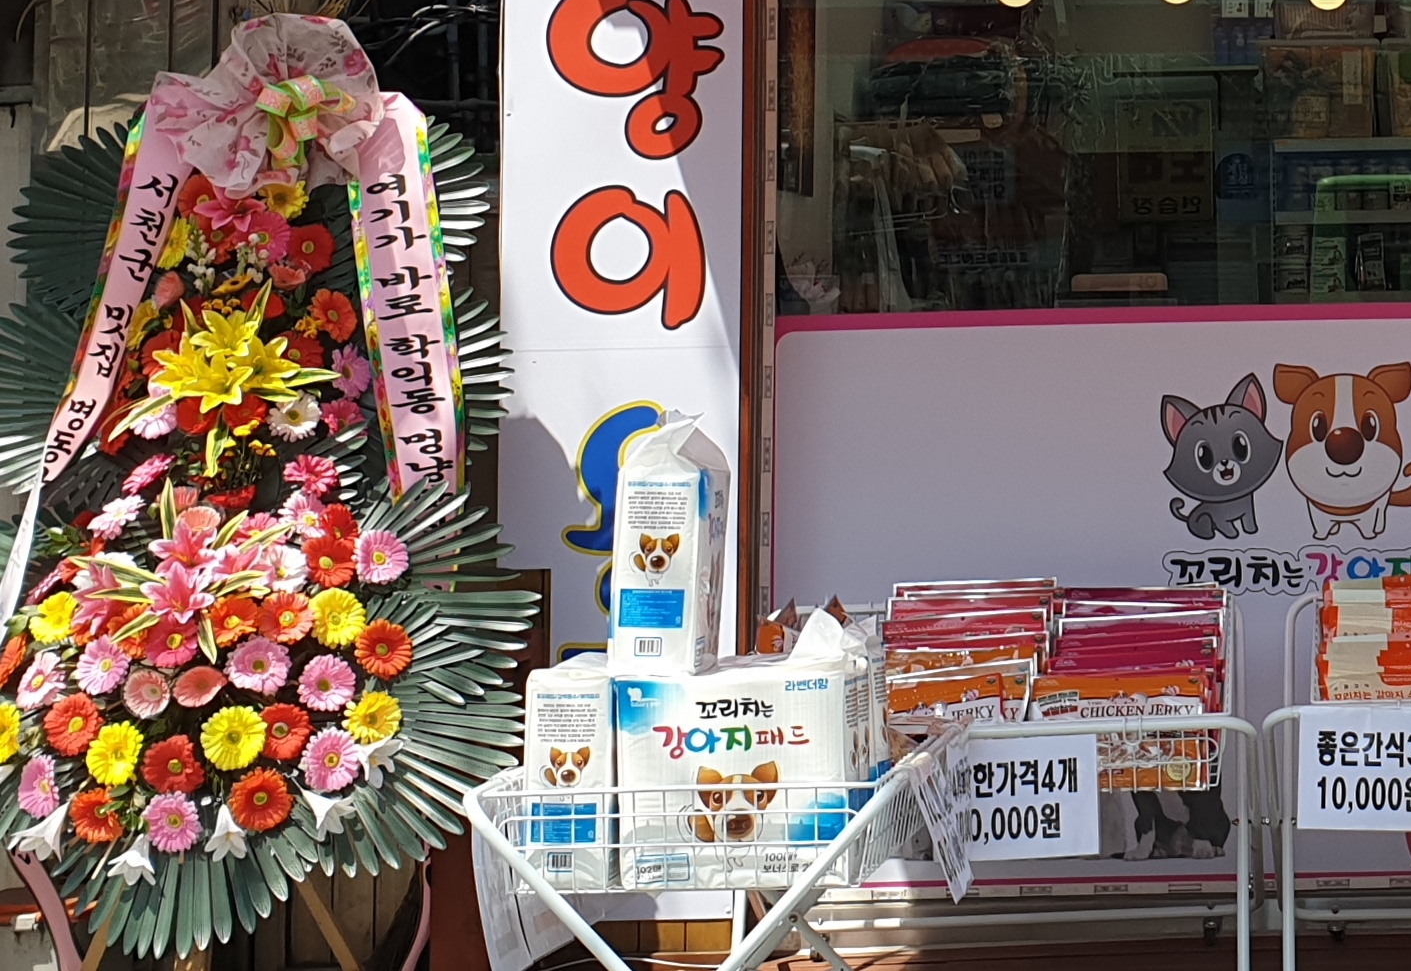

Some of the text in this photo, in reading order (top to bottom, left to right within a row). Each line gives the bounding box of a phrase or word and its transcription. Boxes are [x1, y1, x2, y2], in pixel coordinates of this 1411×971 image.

[119, 173, 179, 282] 서천군
[366, 174, 427, 250] 여기가
[374, 266, 433, 321] 바로
[384, 334, 446, 415] 학익동
[42, 399, 97, 482] 명동
[695, 697, 774, 720] 꼬리치는
[1080, 704, 1194, 719] CHICKEN JERKY
